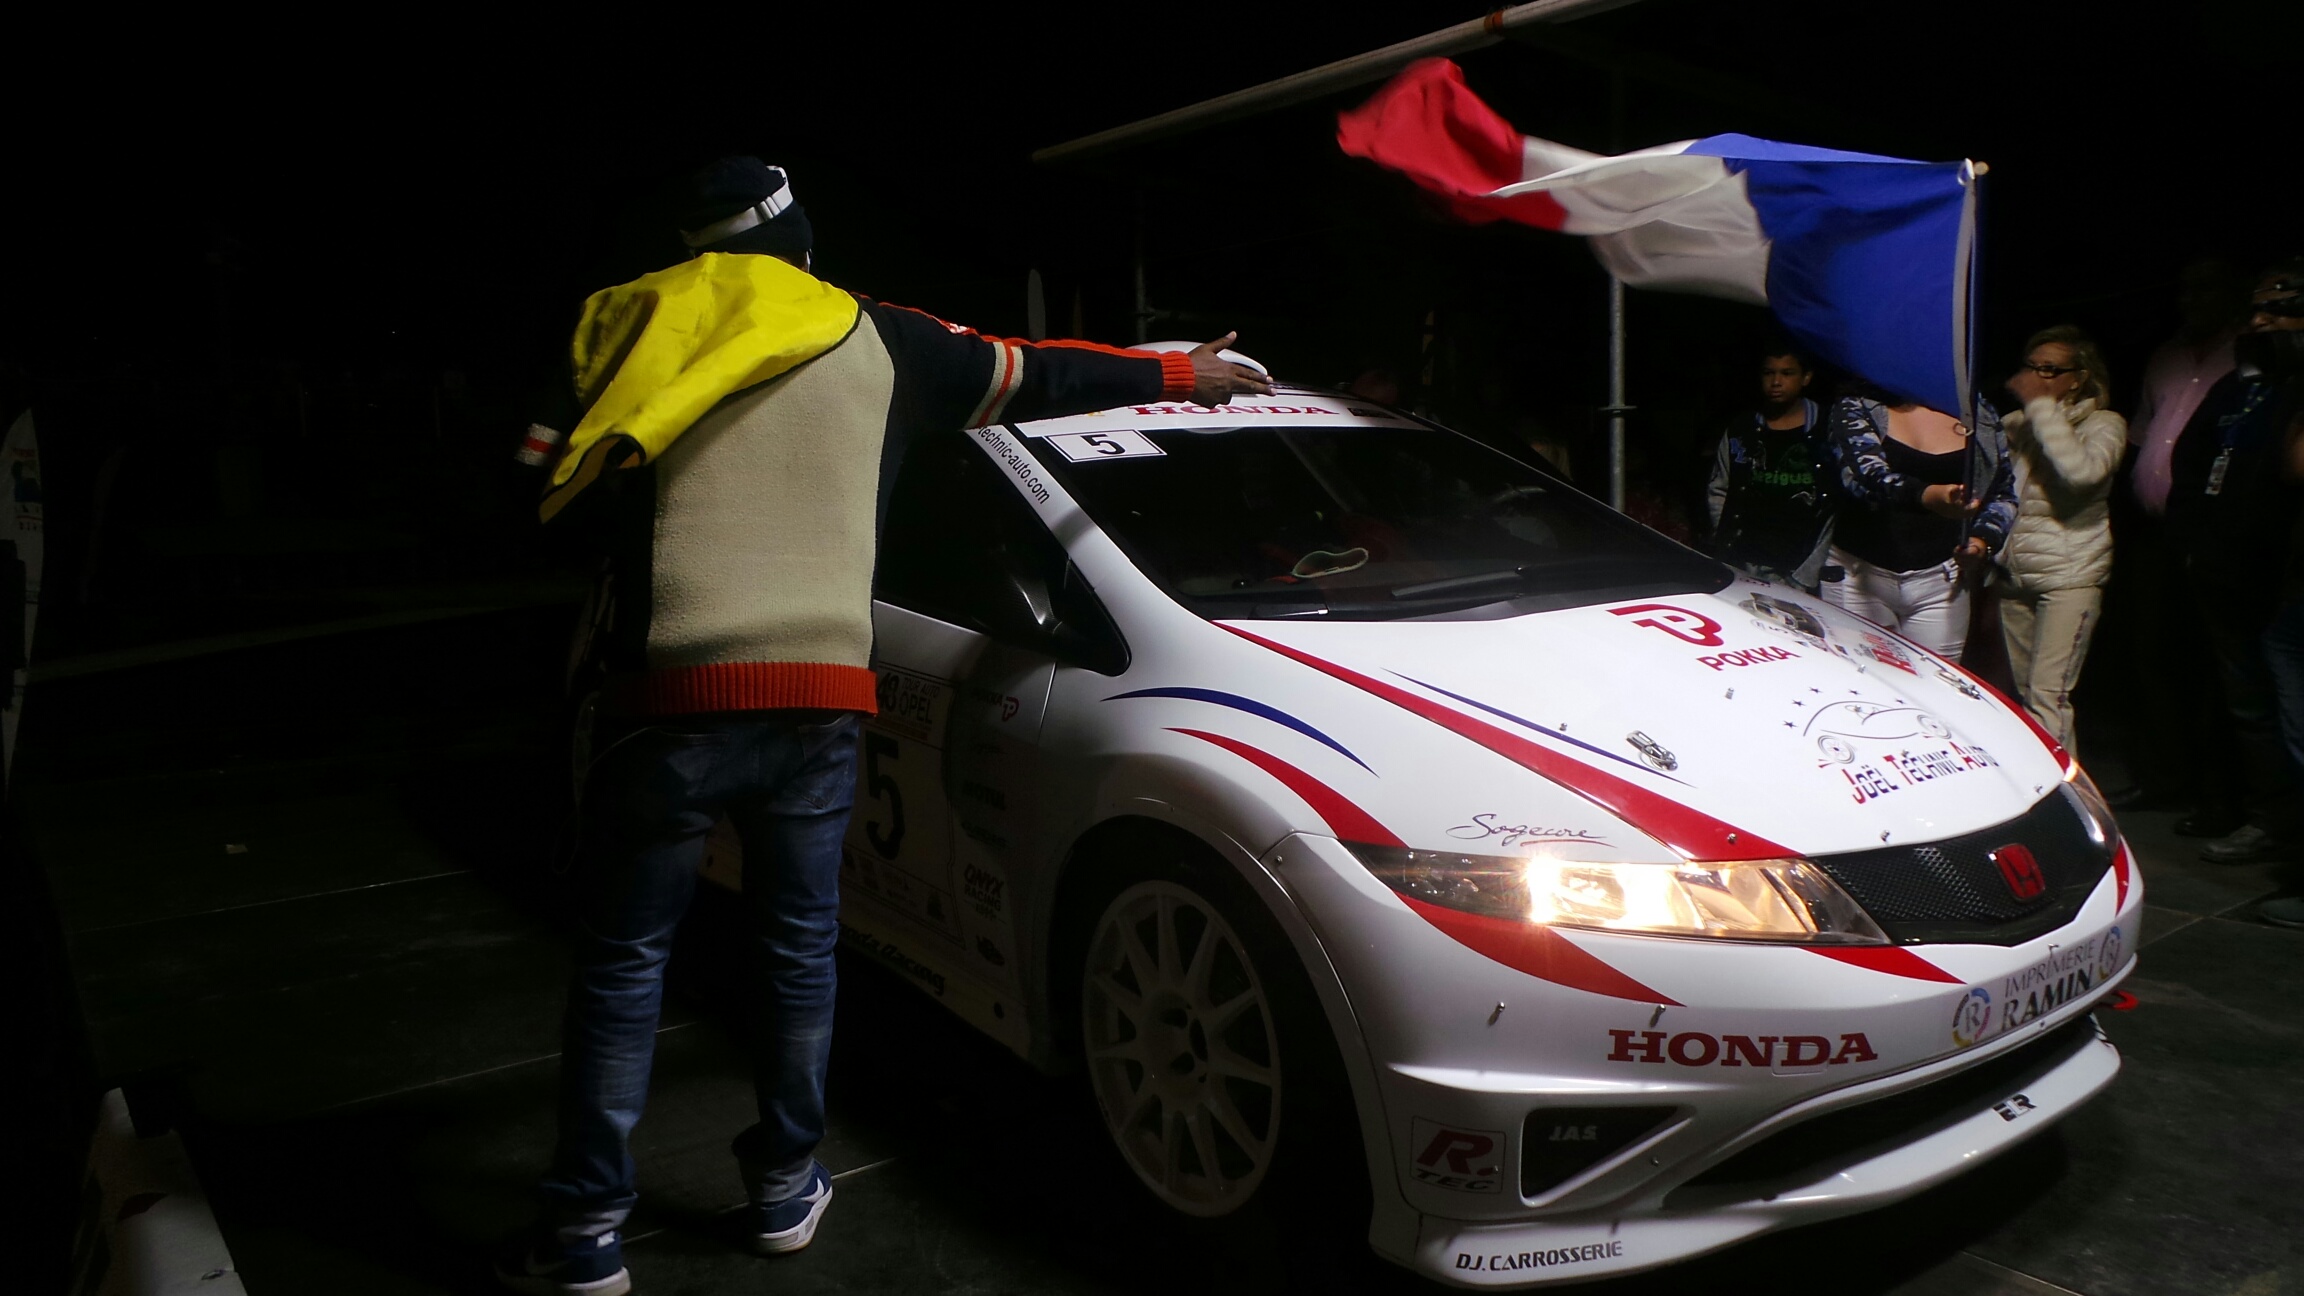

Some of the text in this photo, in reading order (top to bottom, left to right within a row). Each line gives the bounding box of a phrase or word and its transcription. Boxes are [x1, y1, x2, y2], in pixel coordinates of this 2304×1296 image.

[1135, 405, 1339, 416] HONDA
[1080, 433, 1126, 455] 5
[1696, 645, 1802, 672] POKKA
[902, 677, 941, 699] TOUR AUTO
[899, 690, 933, 724] OPEL
[865, 730, 905, 860] 5
[964, 863, 1005, 898] ONYX
[964, 884, 1002, 912] RACING
[2004, 939, 2095, 998] IMPRIMERIE
[2001, 962, 2094, 1031] RAMIN
[1607, 1029, 1879, 1067] HONDA
[1416, 1168, 1495, 1190] TEC
[1489, 1240, 1623, 1272] CARROSSERIE
